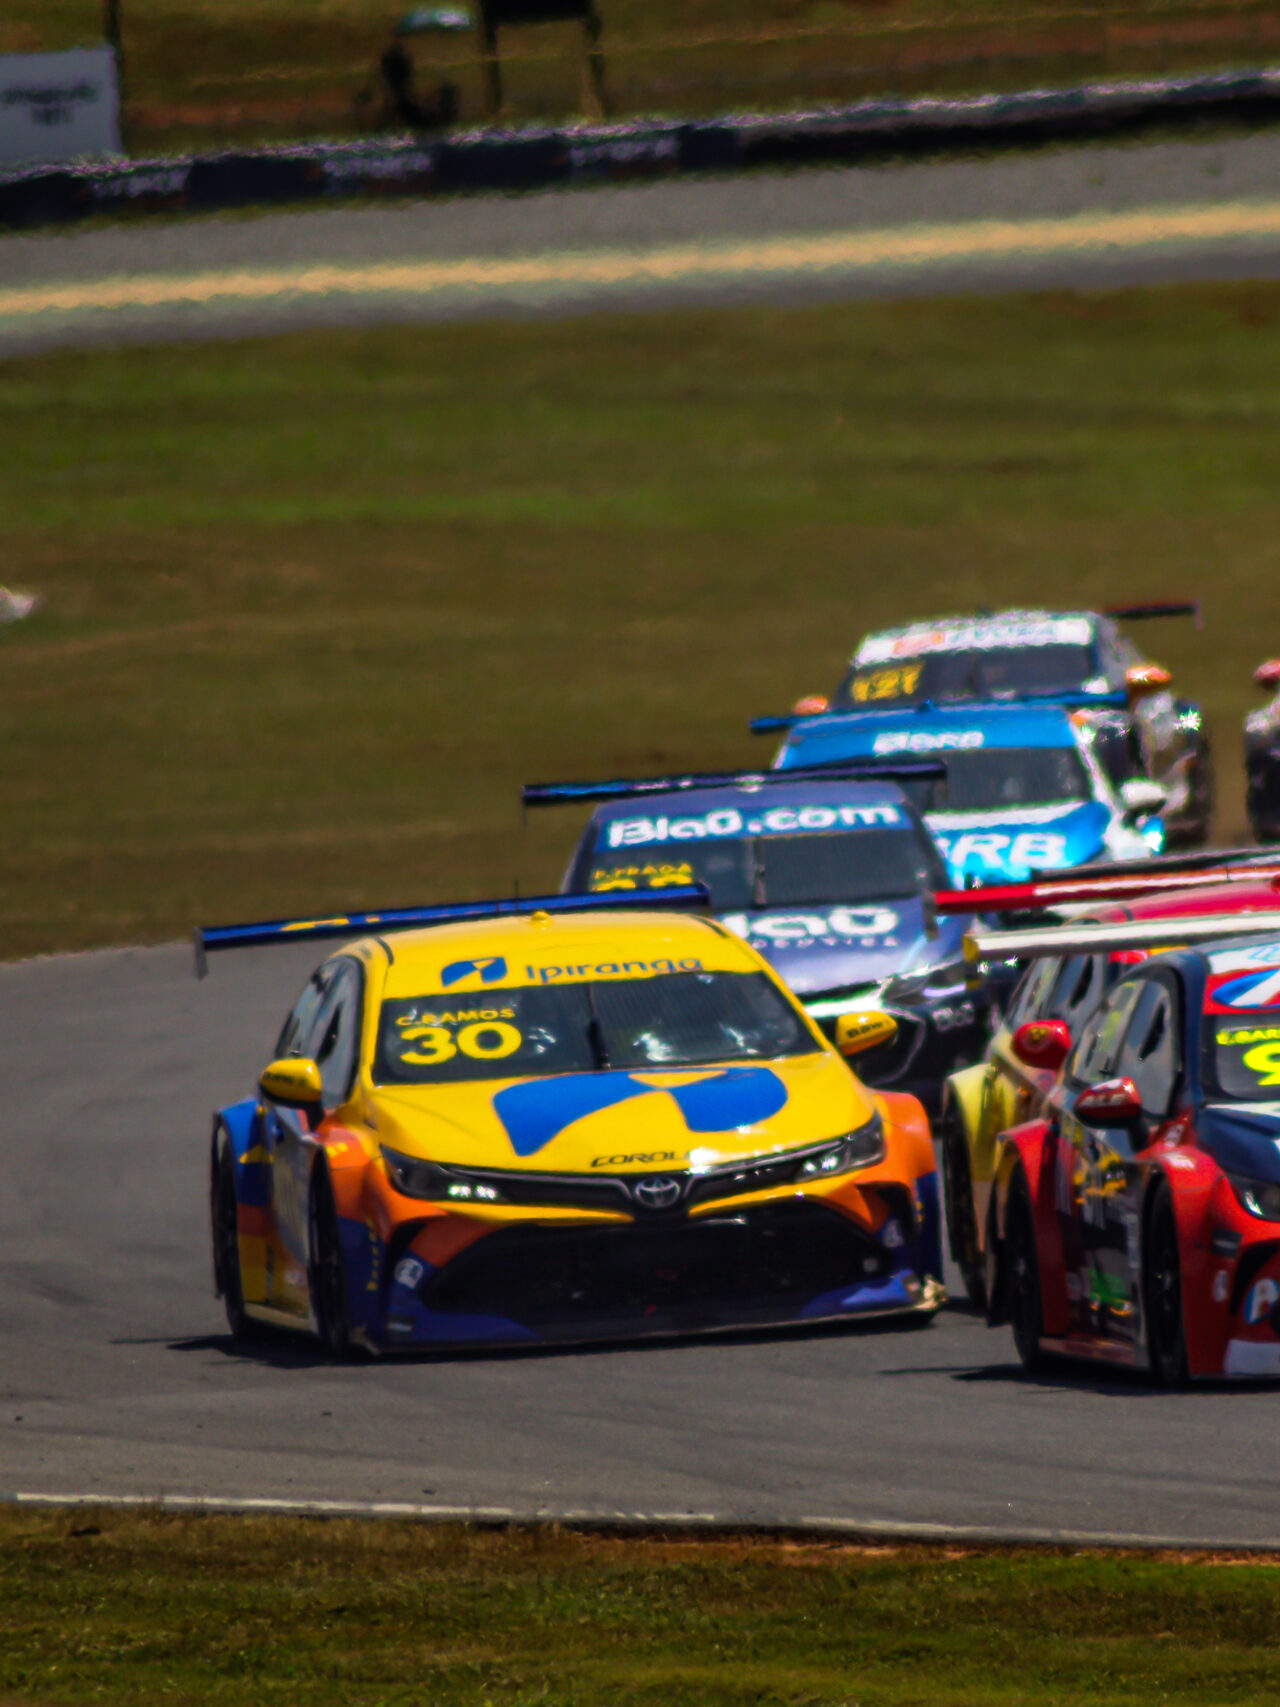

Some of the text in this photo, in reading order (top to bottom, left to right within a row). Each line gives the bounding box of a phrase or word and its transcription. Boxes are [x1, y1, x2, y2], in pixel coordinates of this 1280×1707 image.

[526, 957, 703, 984] Ipiranga
[396, 1007, 516, 1026] C.RAMOS
[400, 1021, 522, 1065] 30
